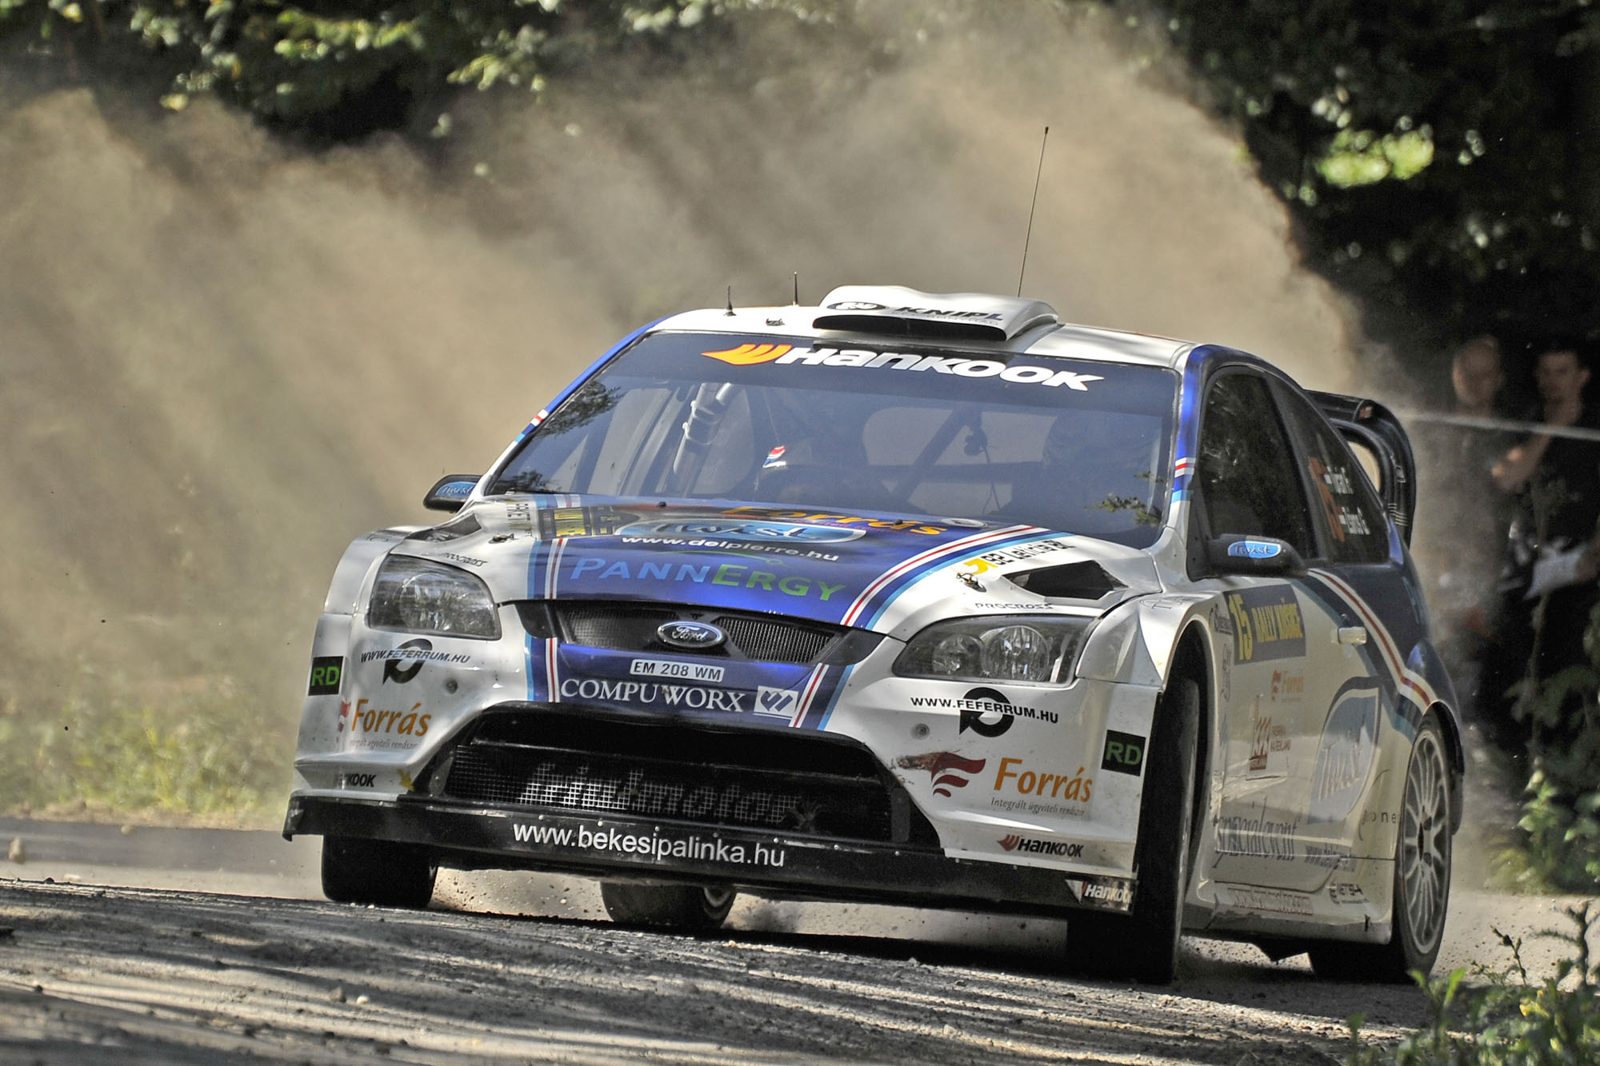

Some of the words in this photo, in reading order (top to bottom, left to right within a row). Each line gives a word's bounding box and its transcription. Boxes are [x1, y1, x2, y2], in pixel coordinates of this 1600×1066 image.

[671, 624, 709, 642] Ford
[311, 666, 340, 686] RD
[633, 661, 657, 675] EM
[660, 663, 690, 678] 208
[695, 667, 723, 682] WM
[351, 698, 432, 737] Forrás
[910, 697, 1059, 724] WWW.FEFERRUM.HU
[1105, 741, 1142, 765] RD
[993, 756, 1093, 803] Forrás
[513, 823, 786, 867] www.bekesipalinka.hu
